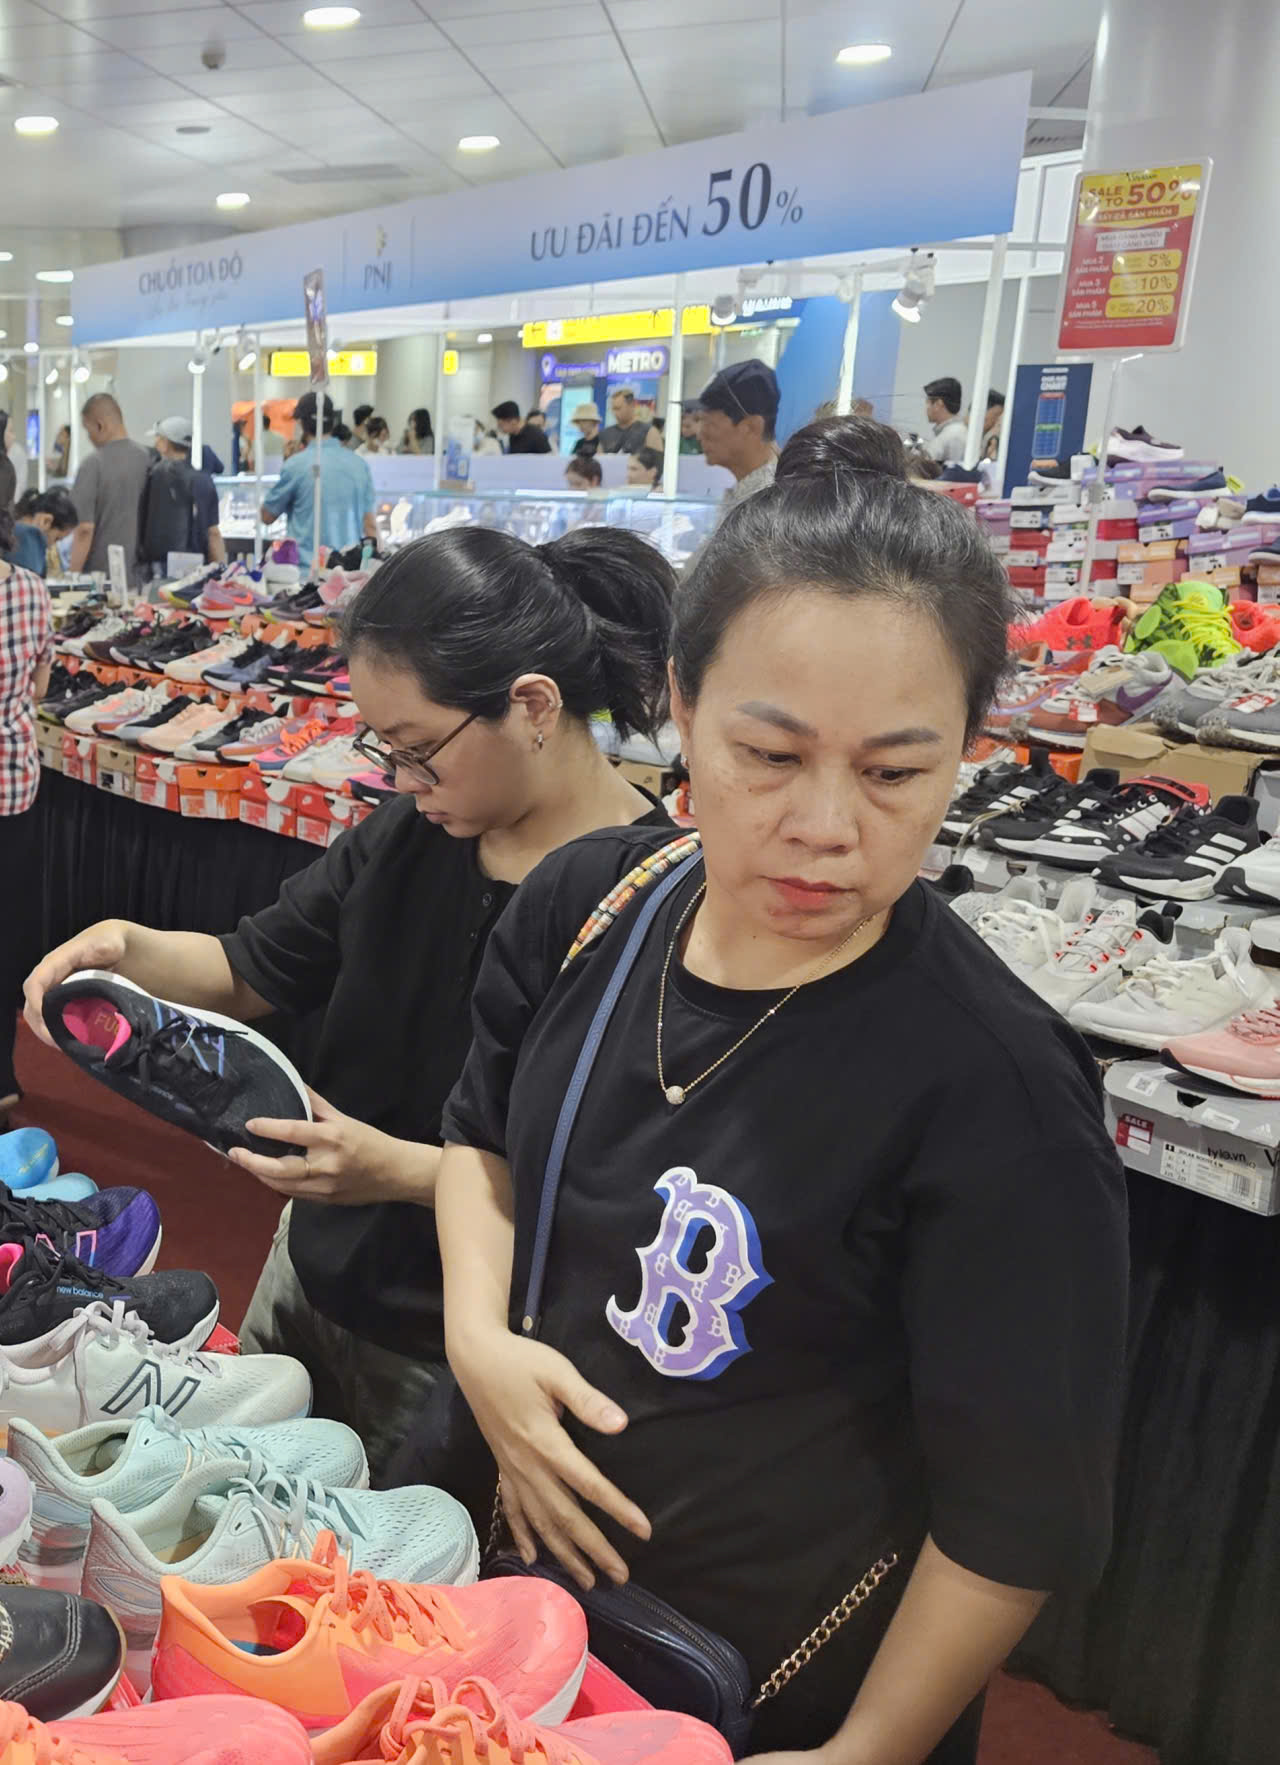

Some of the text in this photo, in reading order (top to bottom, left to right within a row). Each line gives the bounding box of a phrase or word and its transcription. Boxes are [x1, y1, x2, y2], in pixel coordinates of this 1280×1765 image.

[1127, 179, 1192, 206] 50%
[530, 162, 803, 261] ƯU ĐÃI ĐẾN 50%
[1147, 252, 1172, 267] 5%
[1140, 275, 1173, 290] 10%
[1135, 298, 1169, 313] 20%
[607, 350, 665, 374] METRO
[1124, 1115, 1148, 1129] SALE
[56, 1286, 104, 1299] new balance
